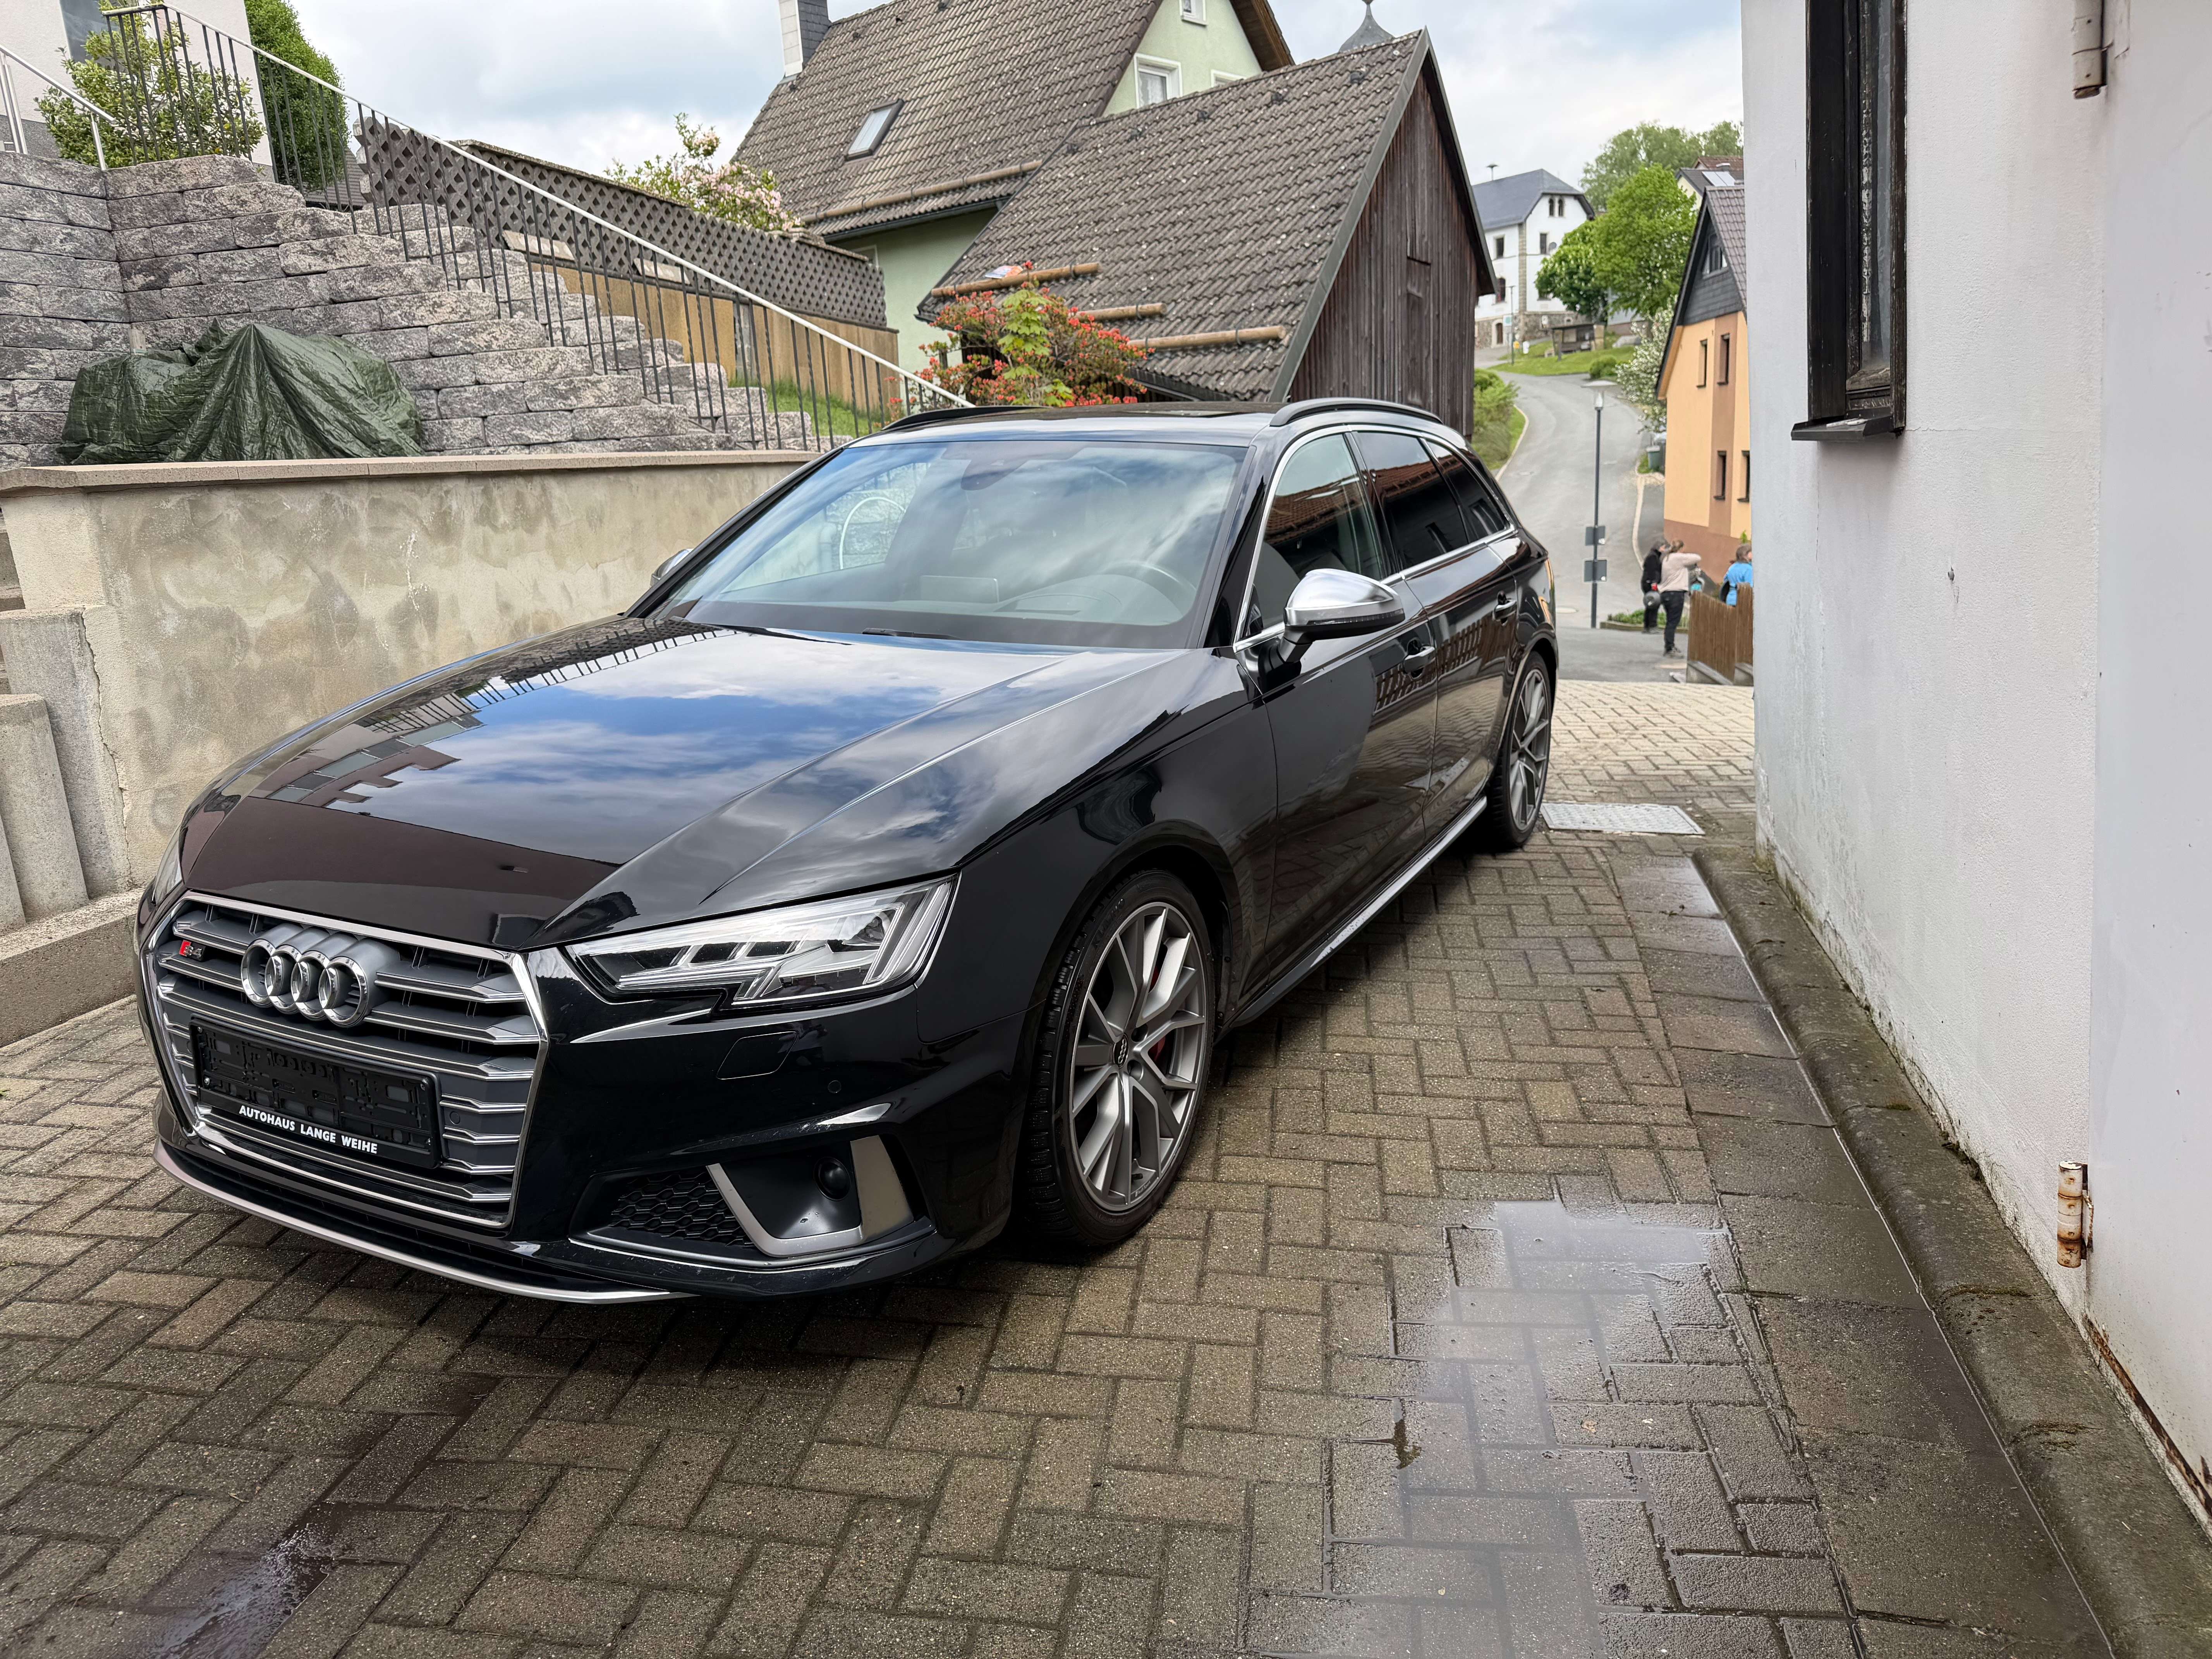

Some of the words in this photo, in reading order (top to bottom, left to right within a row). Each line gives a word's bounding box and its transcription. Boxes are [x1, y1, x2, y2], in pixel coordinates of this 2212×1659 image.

[1091, 898, 1125, 949] KUMHO
[239, 1105, 295, 1131] AUTOHAUS
[301, 1124, 336, 1143] LANGE
[341, 1135, 378, 1154] WEIHE
